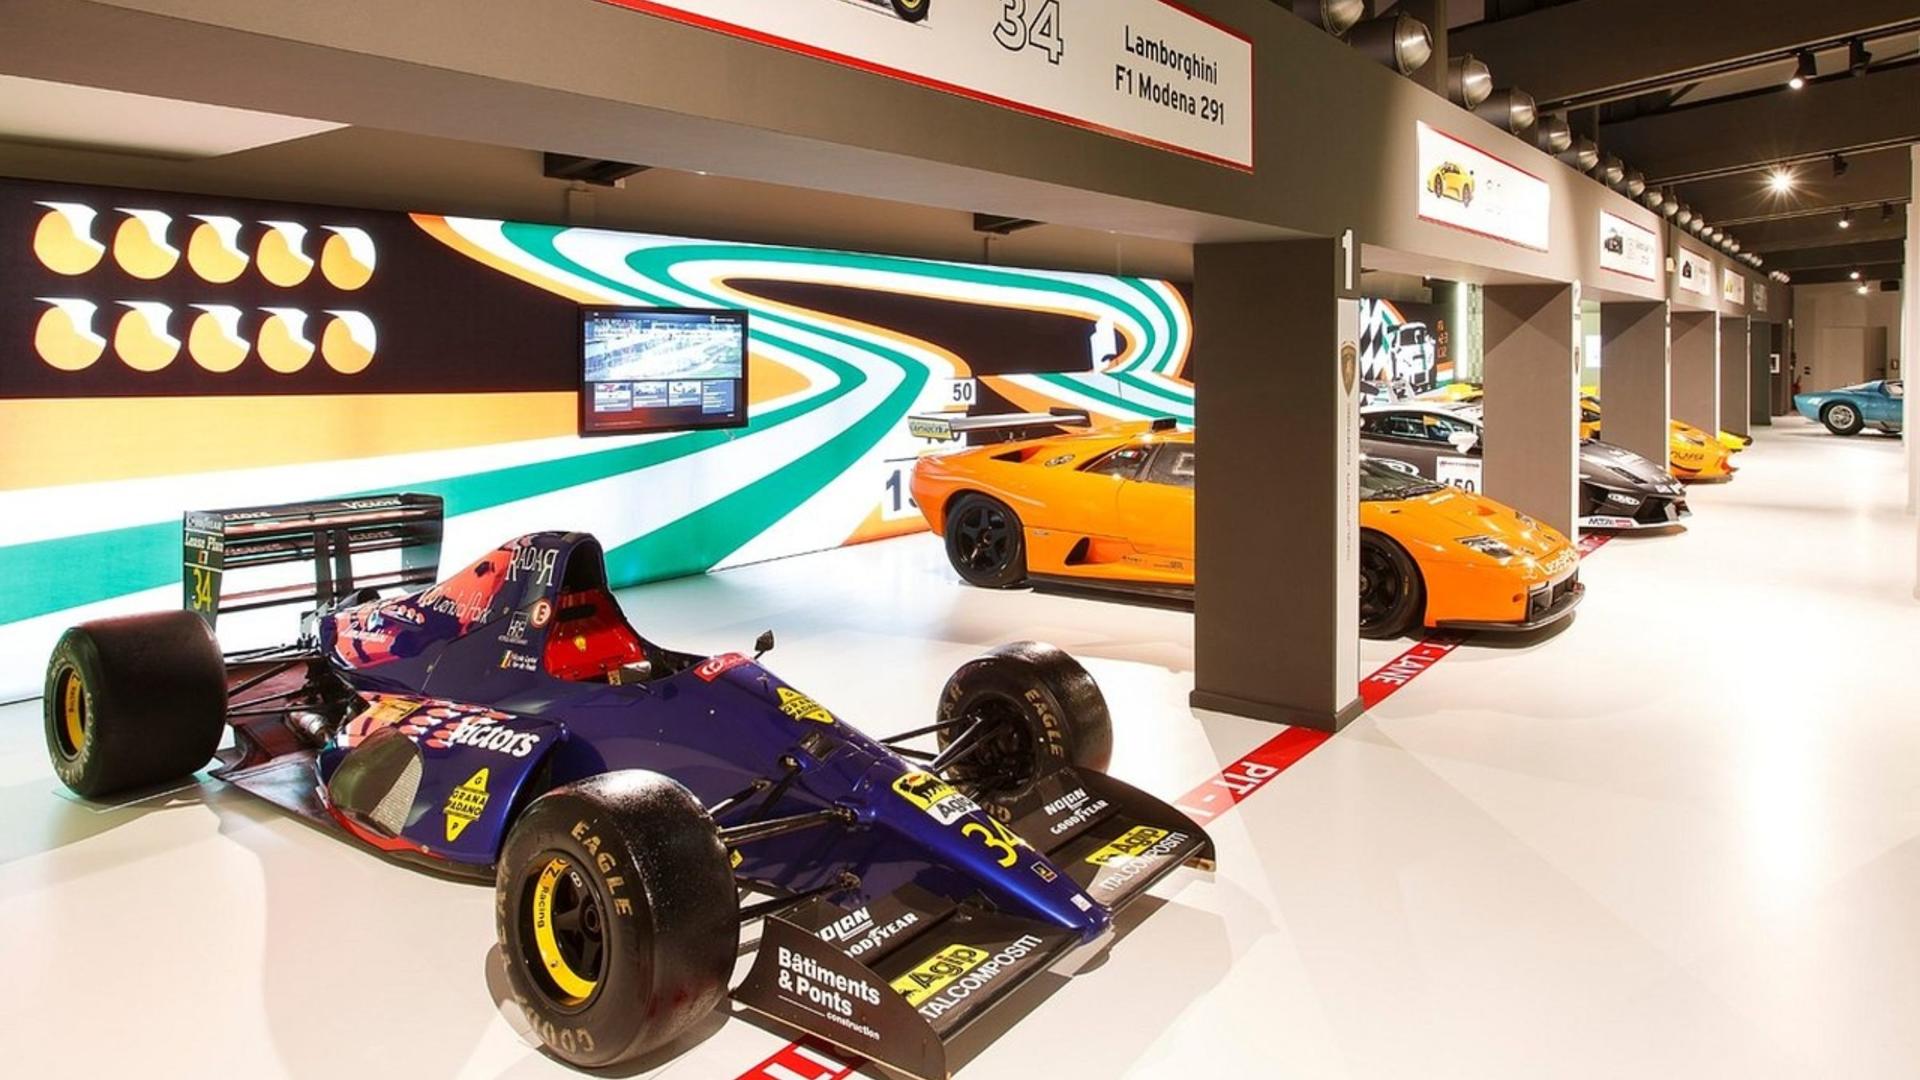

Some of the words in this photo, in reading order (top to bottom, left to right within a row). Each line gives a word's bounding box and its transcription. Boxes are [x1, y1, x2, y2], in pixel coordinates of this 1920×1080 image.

[993, 0, 1063, 65] 34
[1125, 25, 1218, 86] Lamborghini
[1115, 64, 1133, 96] F1
[1138, 75, 1197, 117] Modena
[1200, 95, 1225, 126] 291
[1342, 229, 1353, 290] 1
[953, 382, 973, 402] 50
[192, 567, 212, 613] 34
[1370, 654, 1439, 686] LANE
[450, 716, 541, 758] Victors
[1024, 688, 1065, 760] EAGLE
[452, 789, 486, 806] GRANA
[1213, 760, 1279, 797] PIT
[961, 813, 1036, 868] 34
[571, 819, 634, 917] EAGLE
[537, 885, 550, 929] Racing
[777, 946, 881, 1006] Bâtiments
[911, 945, 977, 991] Agip
[777, 970, 795, 992] &
[798, 976, 854, 1016] Ponts
[826, 1011, 881, 1041] construction
